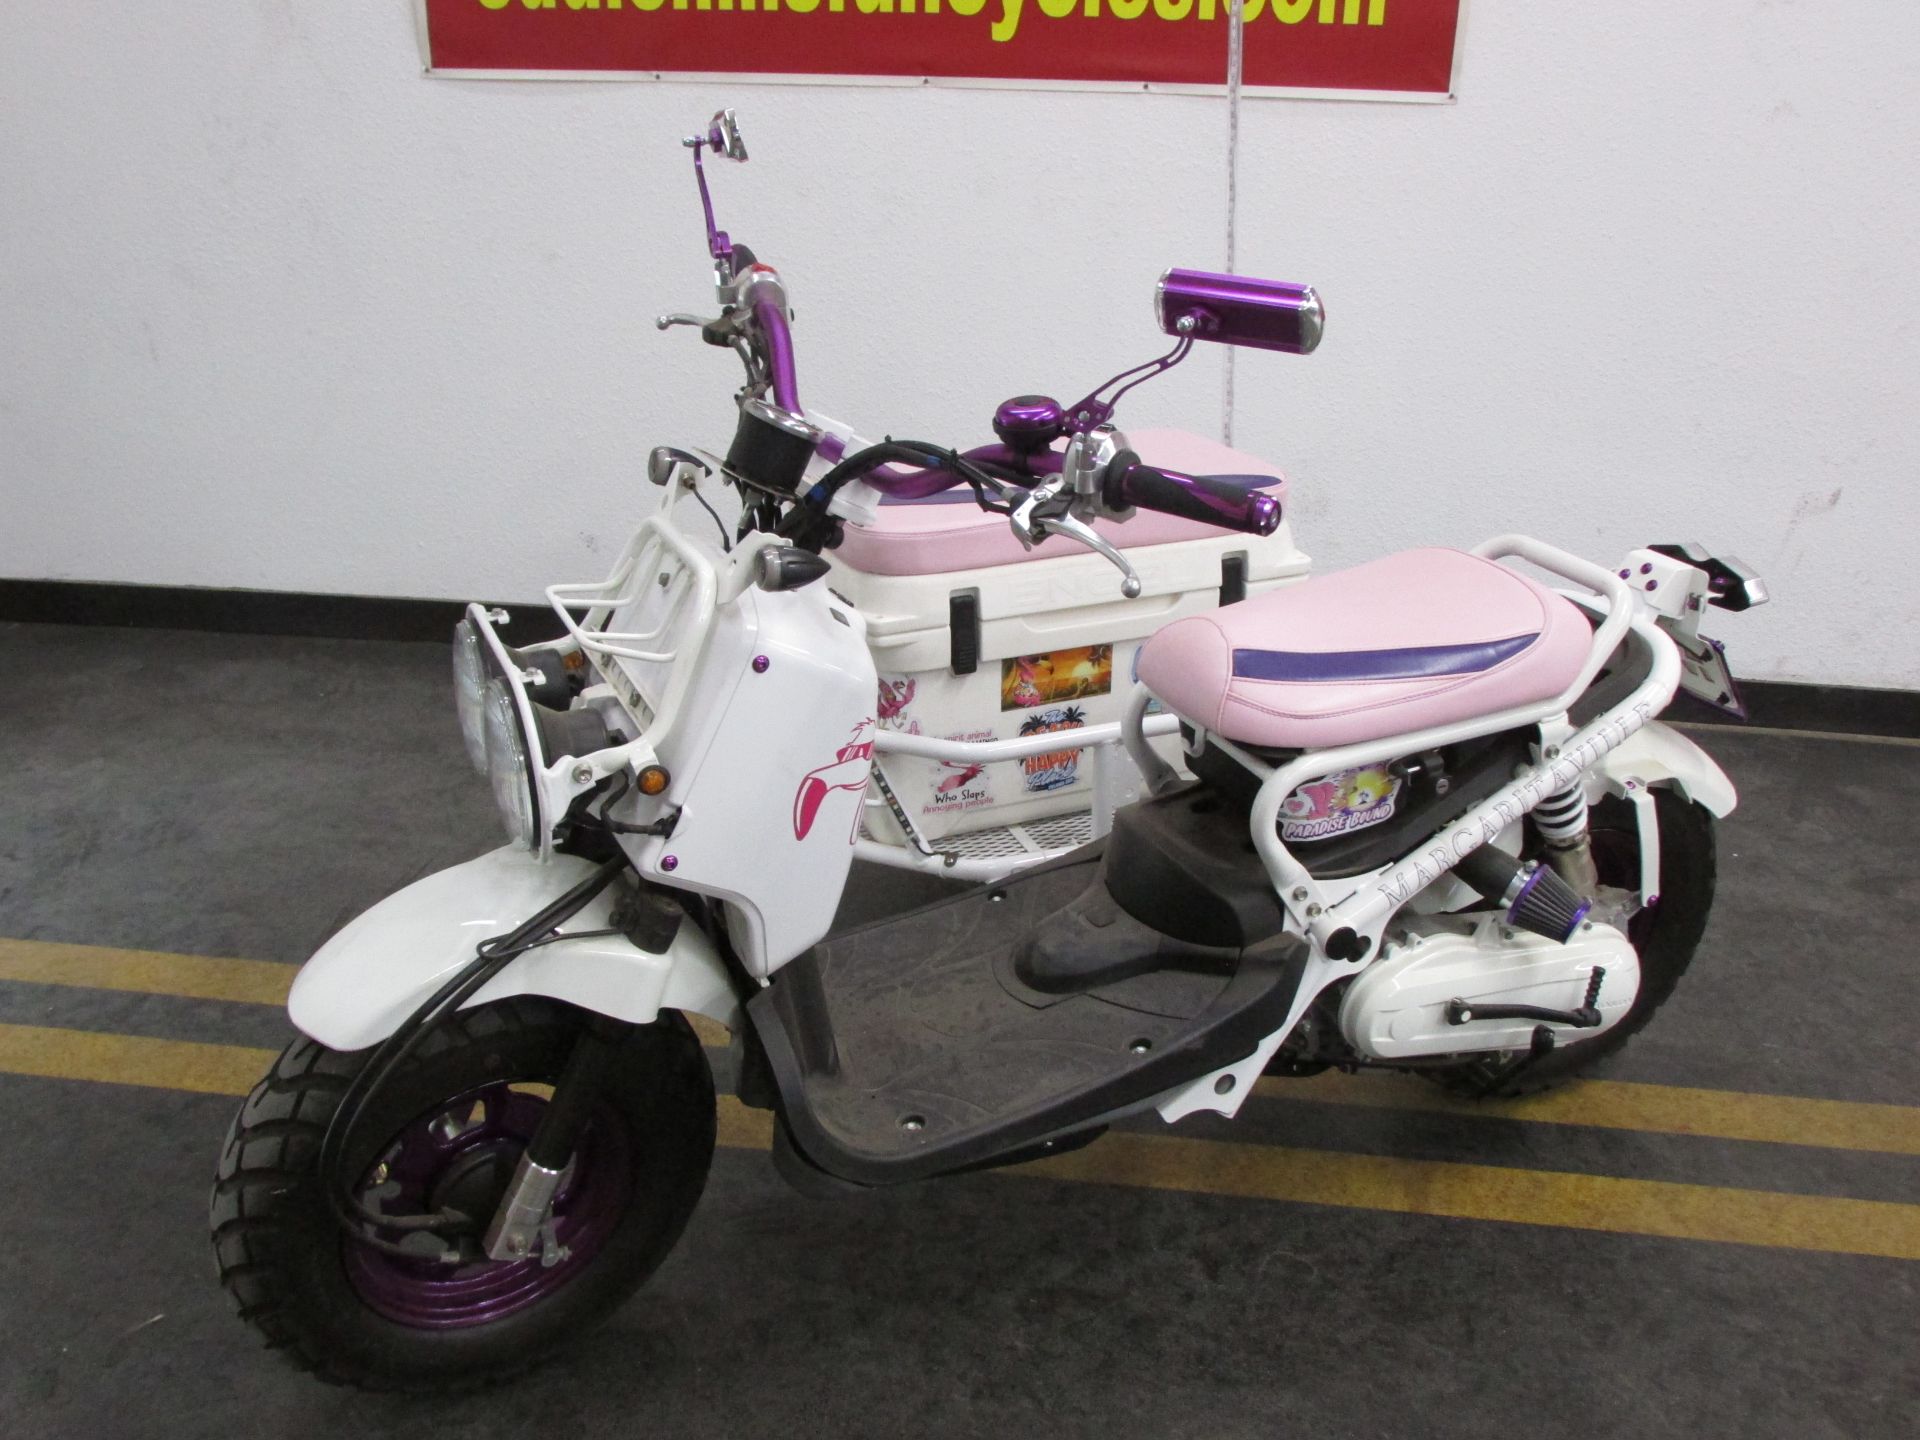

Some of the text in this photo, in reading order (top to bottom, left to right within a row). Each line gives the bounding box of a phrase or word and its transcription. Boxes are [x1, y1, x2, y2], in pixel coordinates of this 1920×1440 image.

[967, 729, 992, 741] animal
[934, 788, 986, 804] Who Slaps
[922, 796, 994, 815] Annoying people
[1286, 814, 1349, 839] PARADISE
